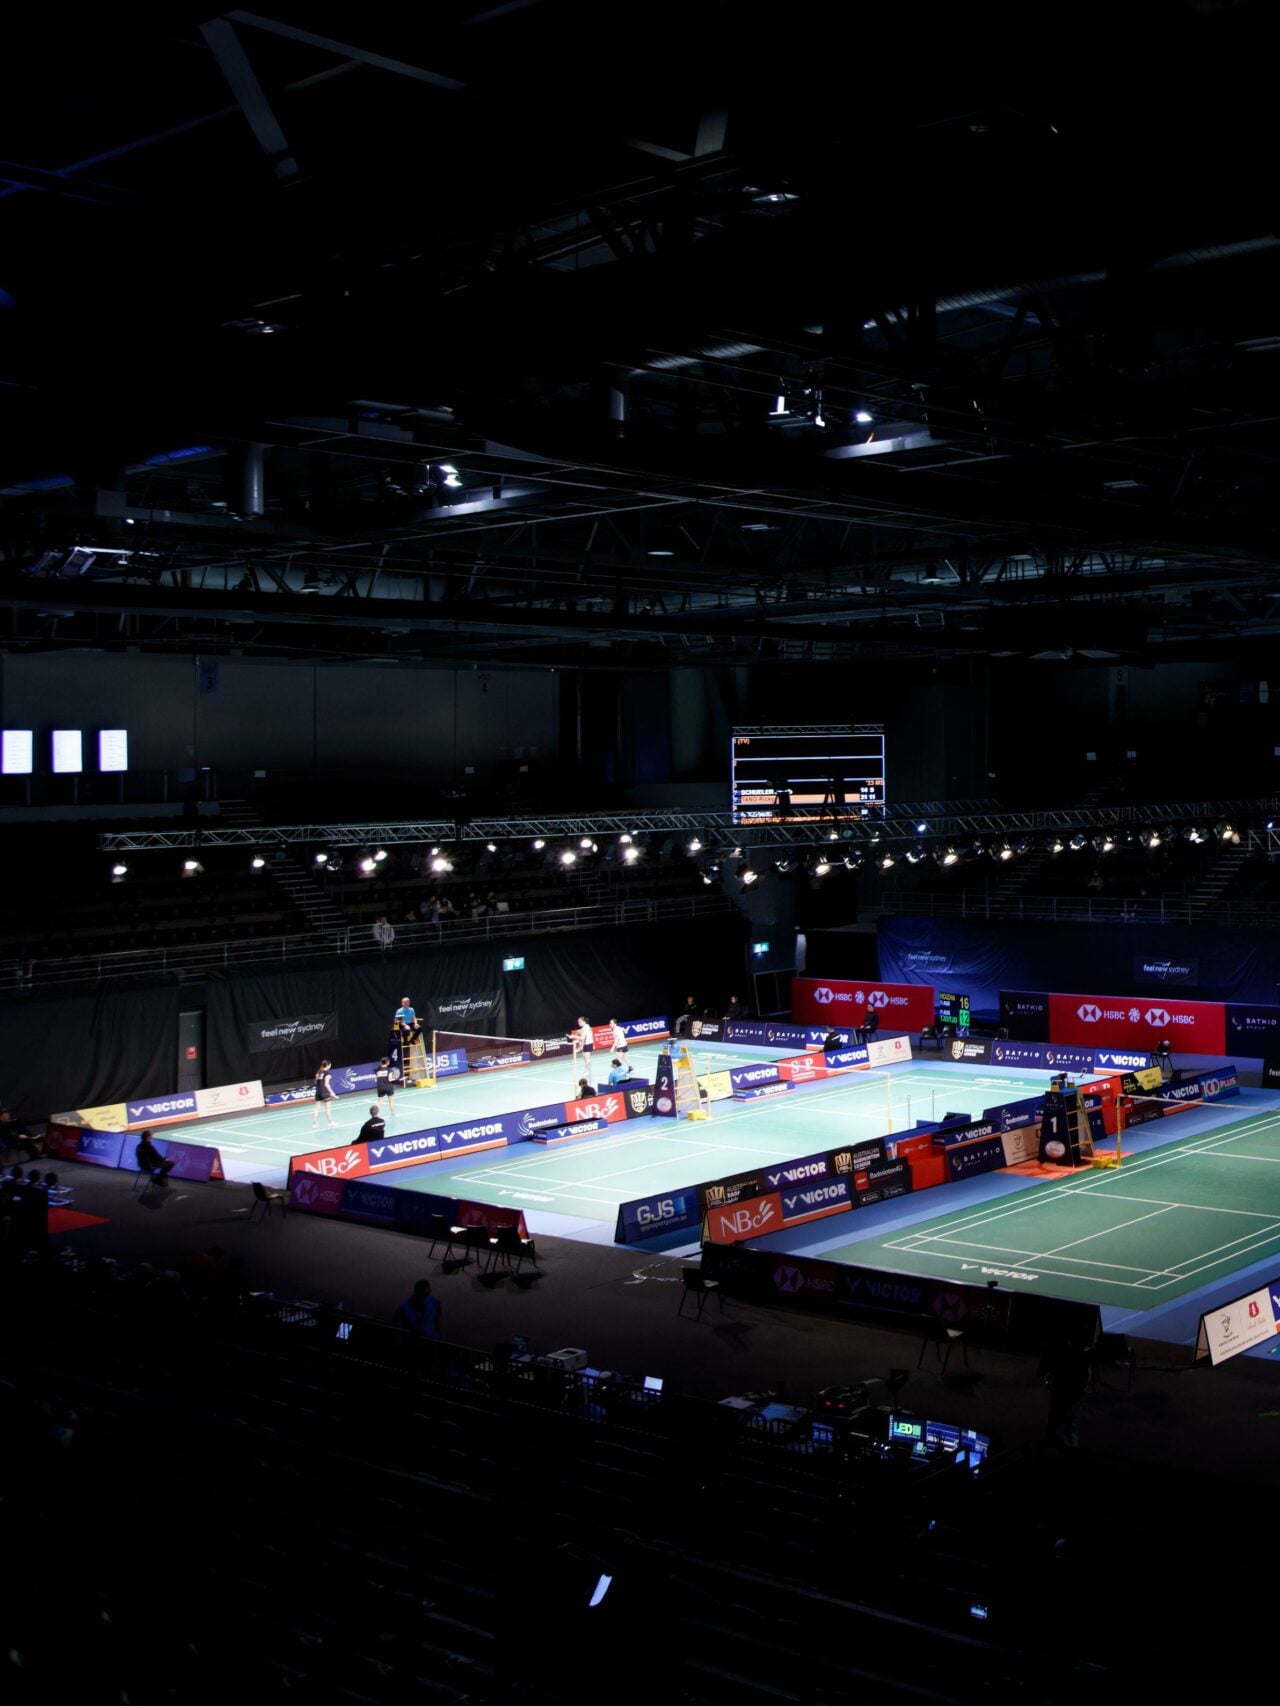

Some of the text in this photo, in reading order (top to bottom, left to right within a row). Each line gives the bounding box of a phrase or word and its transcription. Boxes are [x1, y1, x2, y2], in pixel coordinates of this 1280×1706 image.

[835, 992, 853, 1003] HSBC
[890, 995, 908, 1006] HSBC
[960, 997, 969, 1009] 16
[439, 1000, 493, 1013] feel new sydney
[960, 1012, 969, 1024] 12
[1103, 1010, 1125, 1020] HSBC
[1172, 1014, 1195, 1025] HSBC
[1246, 1017, 1277, 1026] SATHIO
[261, 1022, 325, 1038] feel new sydney
[631, 1020, 665, 1032] VICTOR
[391, 1048, 398, 1062] 4
[838, 1049, 868, 1063] VICTOR
[1005, 1049, 1040, 1058] SATHIO
[1056, 1053, 1092, 1062] SATHIO
[496, 1056, 522, 1065] VICTOR
[1110, 1054, 1147, 1067] VICTOR
[744, 1067, 778, 1081] VICTOR
[1268, 1068, 1280, 1076] feel
[661, 1076, 668, 1091] 2
[291, 1089, 316, 1099] VICTO
[1171, 1083, 1199, 1098] VICTOR
[145, 1097, 194, 1113] VICTOR
[457, 1122, 503, 1139] VICTOR
[570, 1122, 599, 1134] VICTOR
[1050, 1116, 1057, 1133] 1
[965, 1126, 992, 1140] VICTOR
[387, 1136, 436, 1154] VICTOR
[963, 1147, 1001, 1162] SATHIO
[783, 1161, 826, 1182] VICTOR
[799, 1183, 846, 1204] VICTOR
[636, 1199, 675, 1225] GJS
[980, 1267, 1038, 1281] VICTOR
